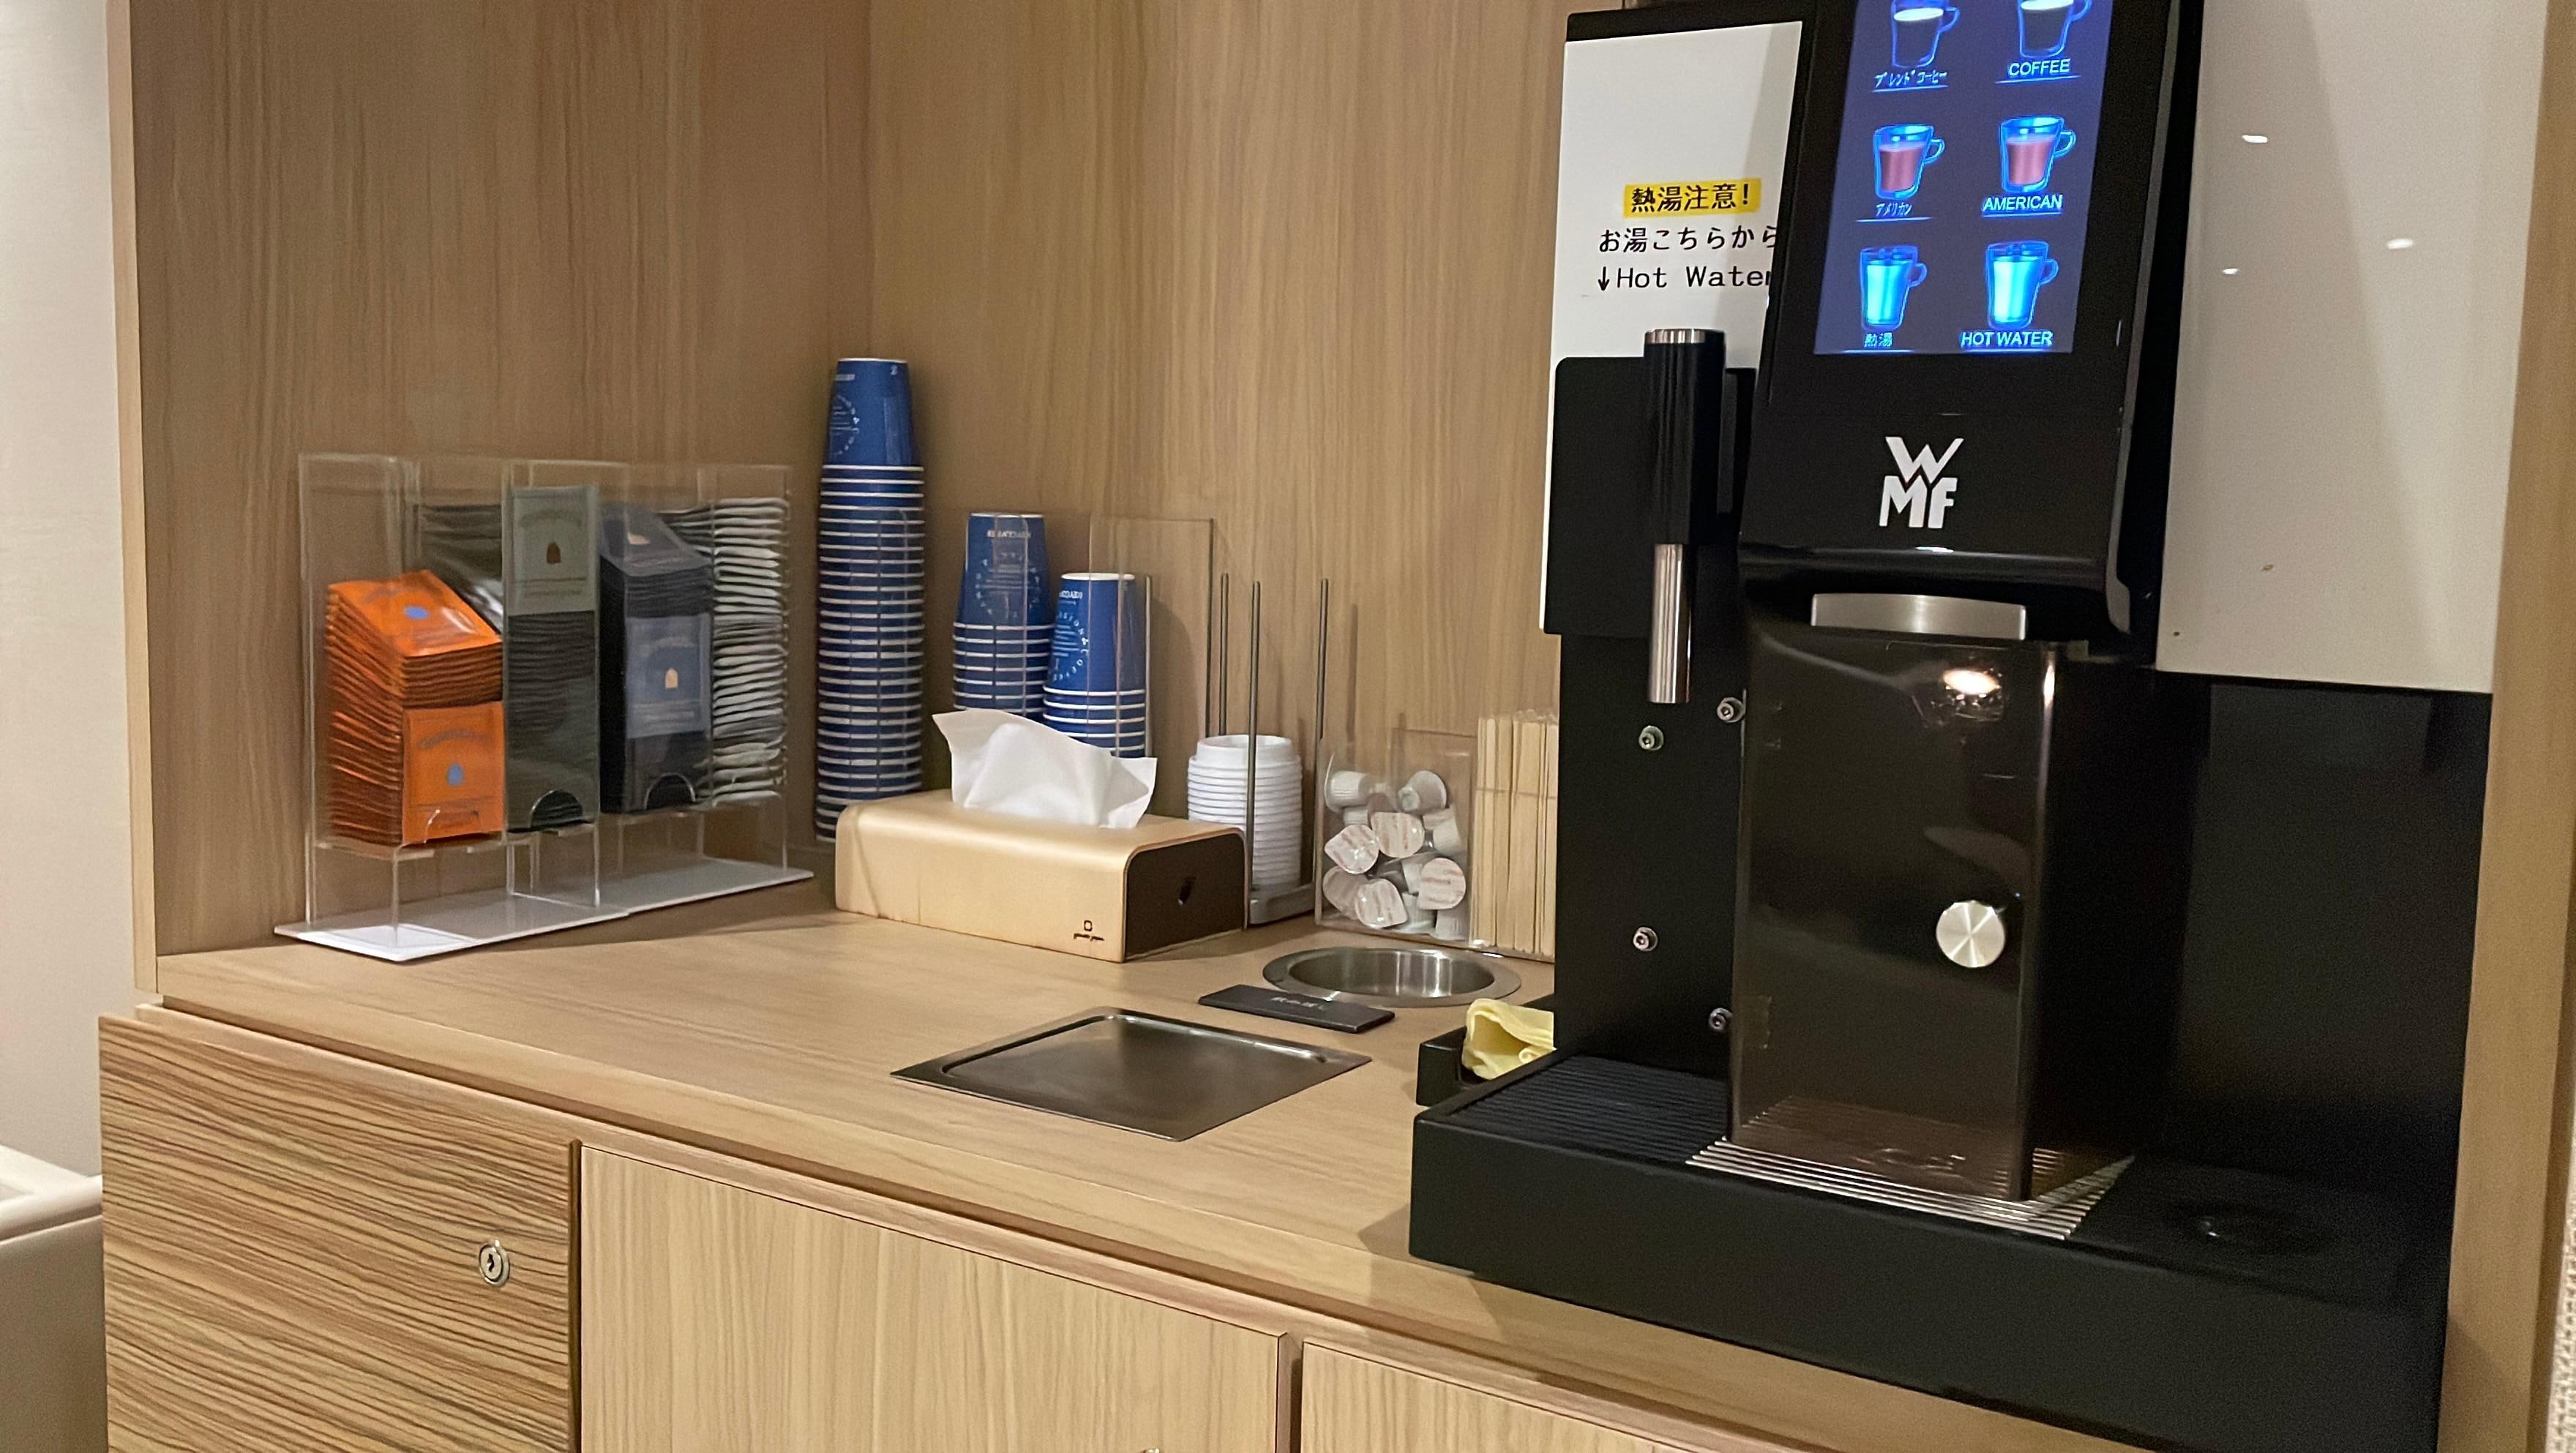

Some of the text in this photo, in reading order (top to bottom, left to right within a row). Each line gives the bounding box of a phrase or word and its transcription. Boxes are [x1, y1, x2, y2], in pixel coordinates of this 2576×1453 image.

[2008, 58, 2071, 76] COFFEE
[1876, 201, 1912, 217] アメリカン
[1982, 194, 2063, 212] AMERICAN
[1598, 225, 1777, 252] お湯こちらから
[1617, 266, 1667, 288] Hot
[1863, 331, 1893, 348] 熱湯
[1961, 331, 2053, 346] HOT WATER
[1879, 436, 1965, 528] WMF
